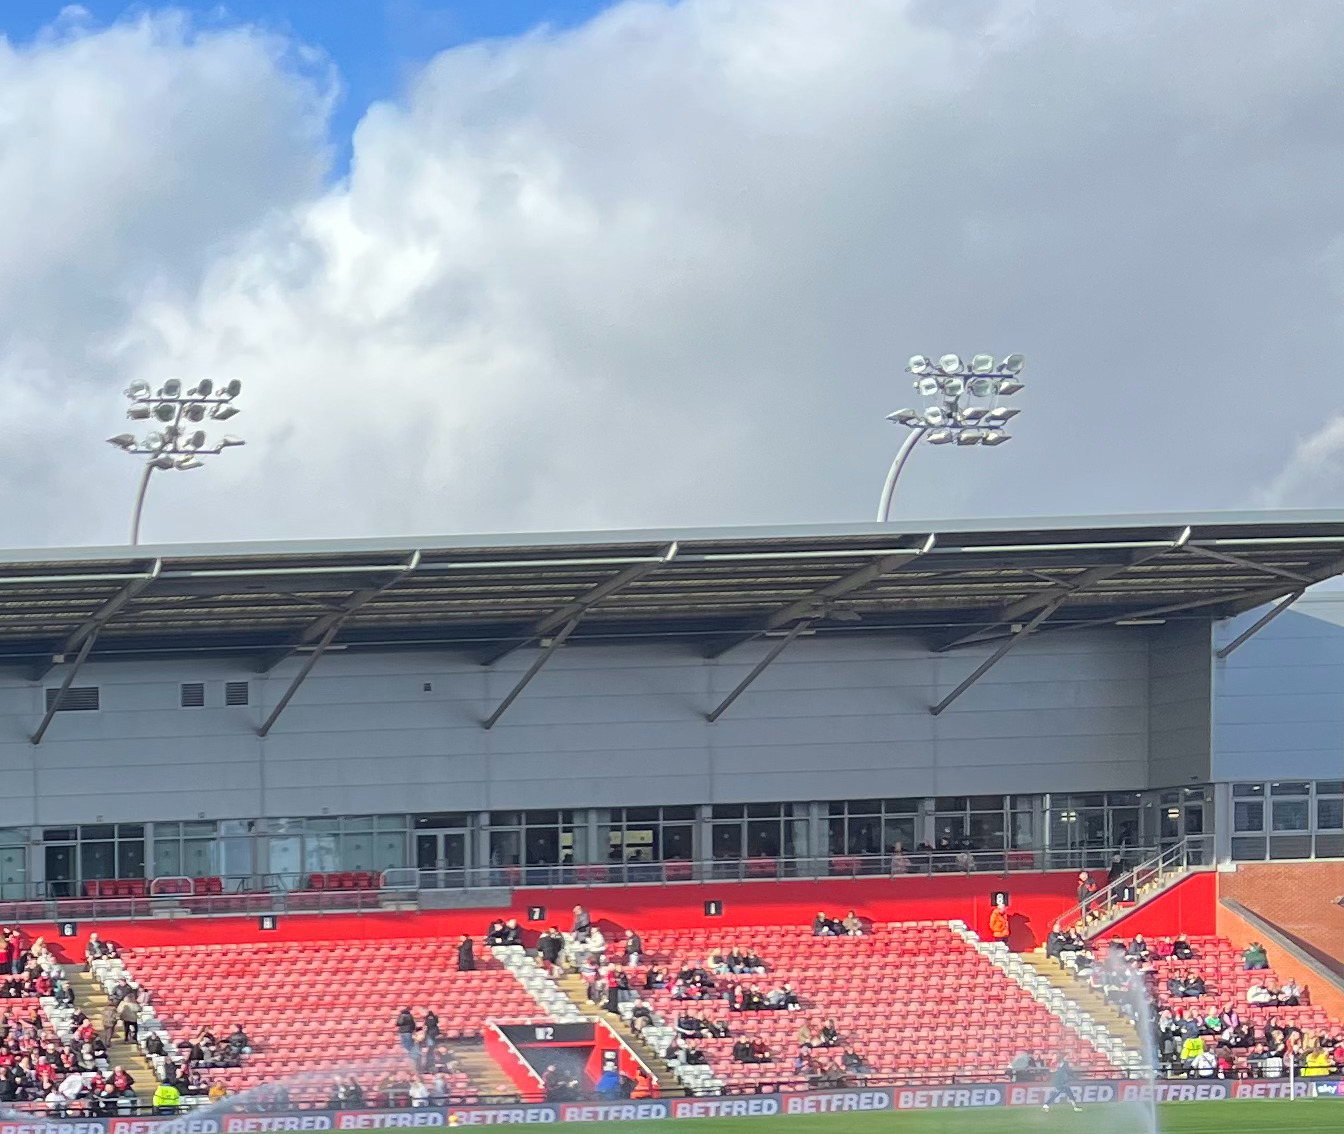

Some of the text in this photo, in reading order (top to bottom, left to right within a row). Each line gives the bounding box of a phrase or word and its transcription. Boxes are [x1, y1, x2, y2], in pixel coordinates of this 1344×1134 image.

[533, 908, 540, 920] 7
[788, 1092, 889, 1113] BETFRED
[899, 1088, 1001, 1108] BETFRED
[565, 1104, 667, 1122] BETFRED
[676, 1099, 777, 1117] BETFRED
[229, 1115, 331, 1133] BETFRED
[341, 1112, 443, 1130] BETFRED
